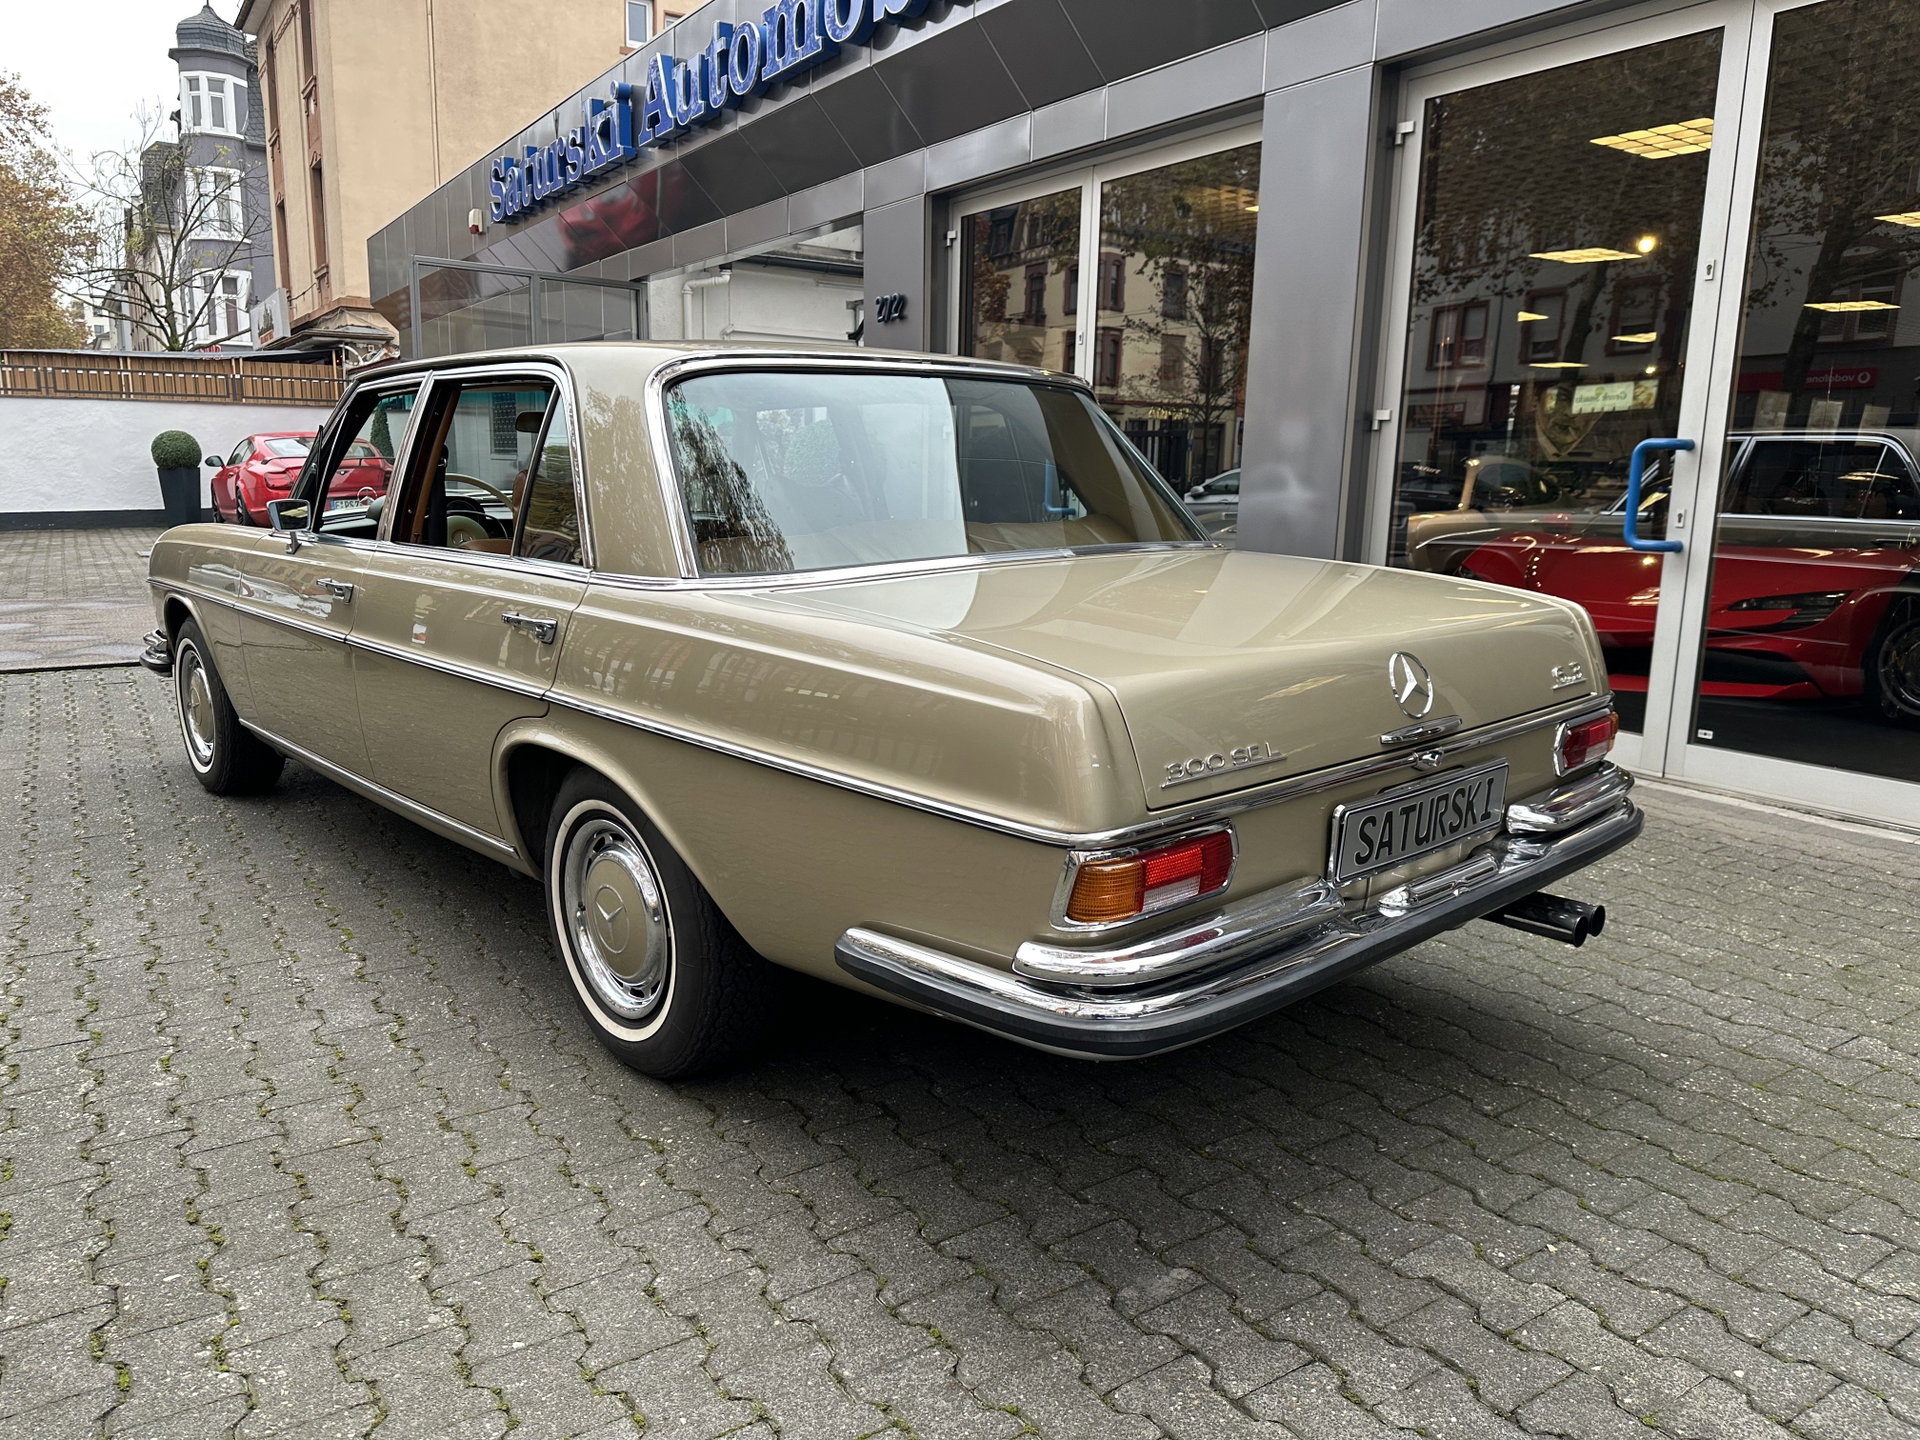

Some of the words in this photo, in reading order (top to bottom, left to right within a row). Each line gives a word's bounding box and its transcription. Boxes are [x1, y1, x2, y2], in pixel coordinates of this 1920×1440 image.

[489, 80, 630, 222] Saturski
[638, 0, 914, 147] Automo
[1166, 753, 1225, 780] 300
[1230, 741, 1283, 767] SEL
[1354, 777, 1494, 866] SATURSKI
